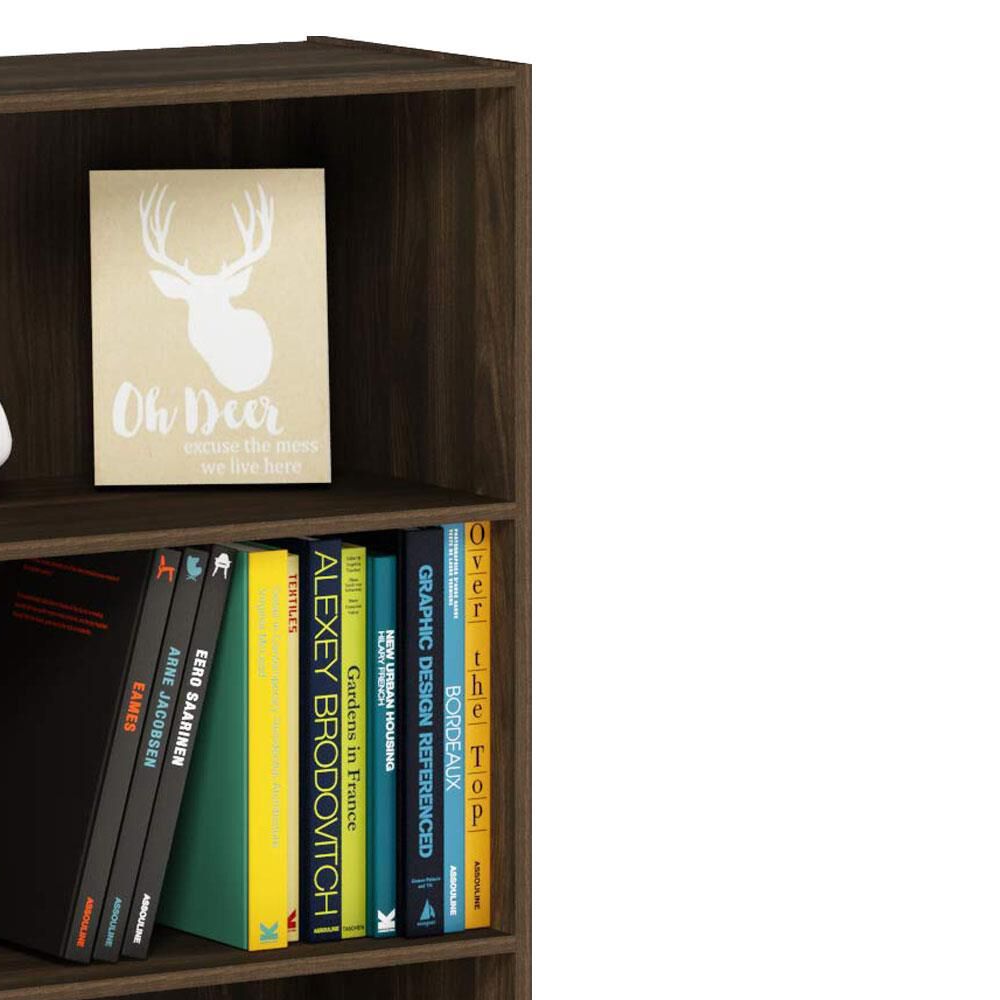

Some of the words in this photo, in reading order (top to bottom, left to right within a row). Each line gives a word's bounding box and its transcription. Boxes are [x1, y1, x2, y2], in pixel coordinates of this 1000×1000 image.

[112, 381, 178, 438] Oh
[184, 386, 285, 436] Deer
[184, 440, 240, 455] excuse
[244, 437, 272, 454] the
[276, 439, 319, 453] mess
[201, 461, 225, 475] we
[230, 458, 260, 475] live
[264, 457, 302, 474] here
[470, 523, 485, 619] Over
[288, 574, 298, 634] TEXTILES
[314, 551, 339, 683] ALEXEY
[418, 564, 434, 651] GRAPHIC
[162, 647, 181, 686] ARNE
[190, 649, 209, 687] EERO
[378, 631, 386, 665] HILARY
[385, 629, 395, 660] NEW
[124, 681, 146, 732] EAMES
[347, 665, 361, 741] Gardens
[377, 667, 386, 707] FRENCH
[385, 663, 395, 708] URBAN
[418, 656, 434, 727] DESIGN
[471, 652, 484, 719] the
[144, 691, 171, 768] JACOBSEN
[171, 692, 199, 767] SAARINEN
[347, 746, 361, 764] in
[385, 712, 395, 772] HOUSING
[445, 685, 462, 792] BORDEAUX
[314, 694, 338, 916] BRODOVITCH
[347, 769, 361, 832] France
[418, 732, 434, 859] REFERENCED
[470, 744, 485, 827] Top
[133, 893, 151, 945] ASSOULINE
[449, 865, 457, 917] ASSOULINE
[76, 896, 95, 948] ASSOULINE
[105, 896, 123, 948] ASSOULINE
